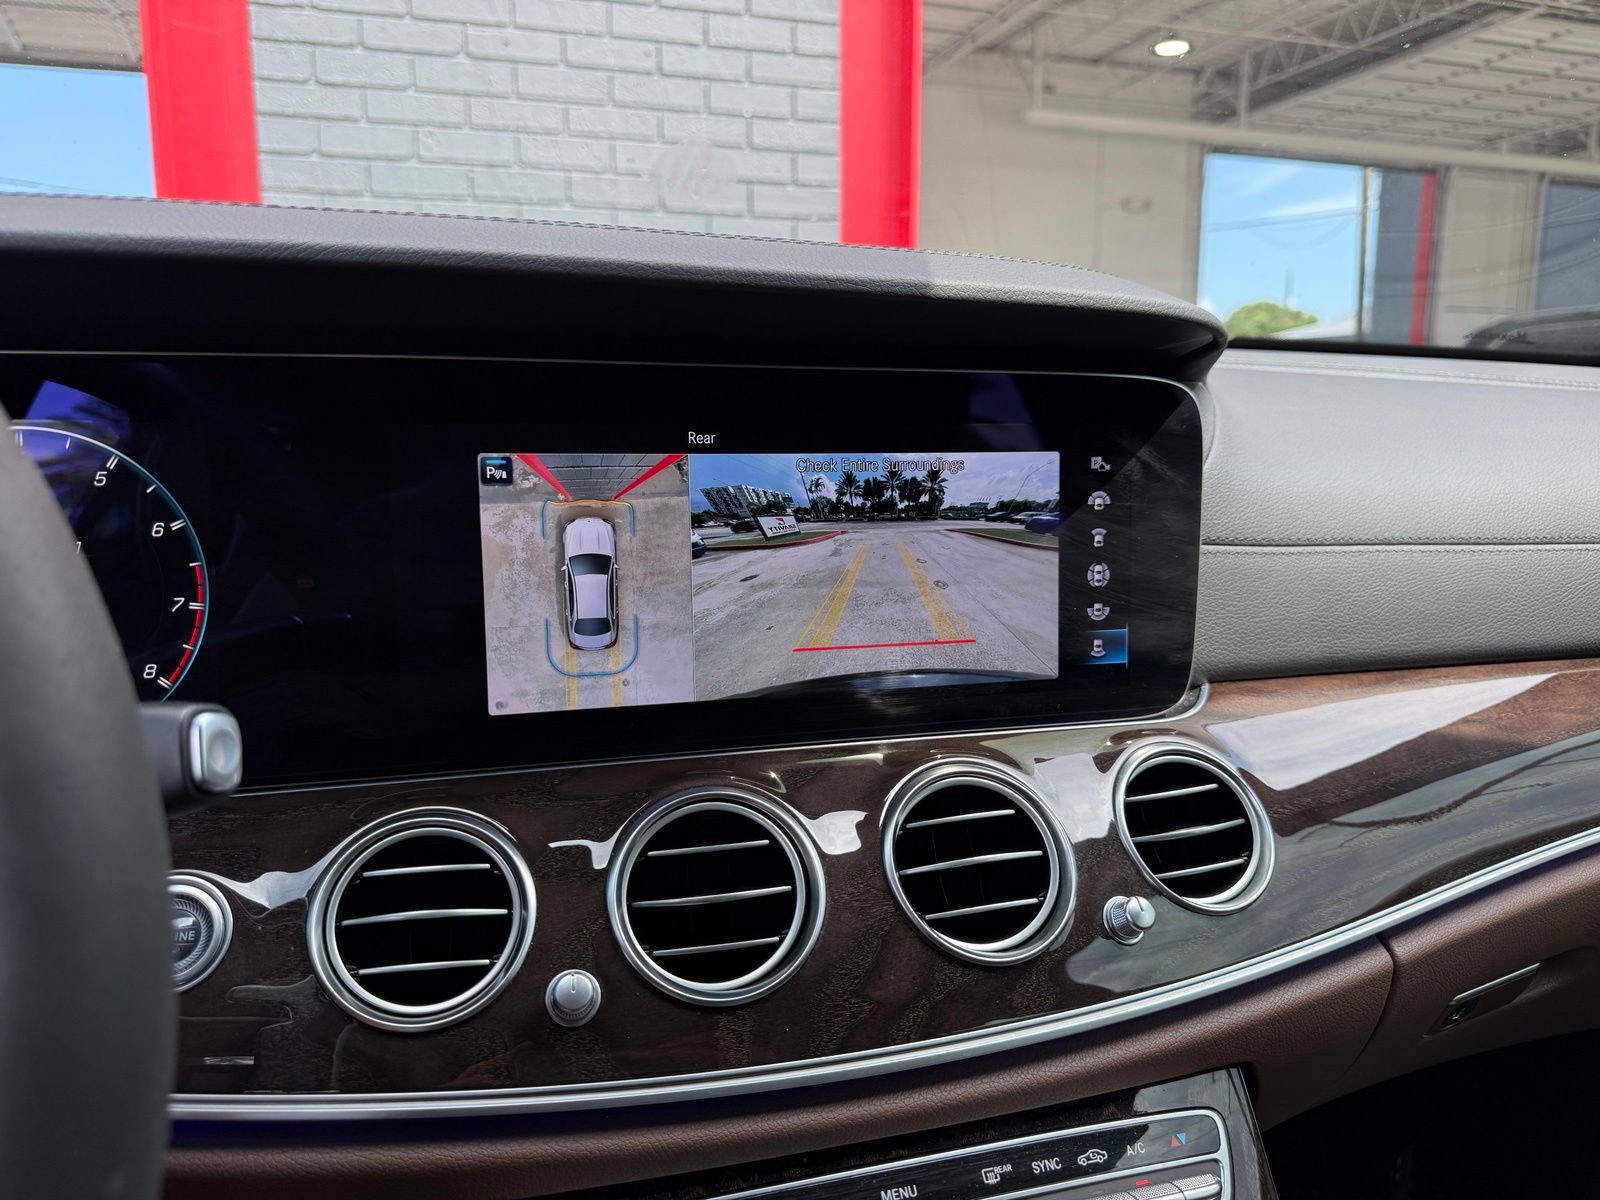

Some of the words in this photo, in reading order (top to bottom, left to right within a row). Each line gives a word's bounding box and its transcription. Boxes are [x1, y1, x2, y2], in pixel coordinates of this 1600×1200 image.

[688, 431, 716, 444] Rear
[796, 458, 837, 472] Check
[841, 458, 879, 472] Entire
[882, 457, 965, 475] Surroundings
[94, 471, 107, 486] 5
[152, 522, 165, 537] 6
[171, 597, 185, 612] 7
[143, 664, 157, 679] 8
[174, 930, 195, 941] INE
[1127, 1142, 1146, 1157] A/C
[994, 1163, 1013, 1174] REAR
[1031, 1157, 1062, 1174] SYNC
[880, 1184, 918, 1200] MENU
